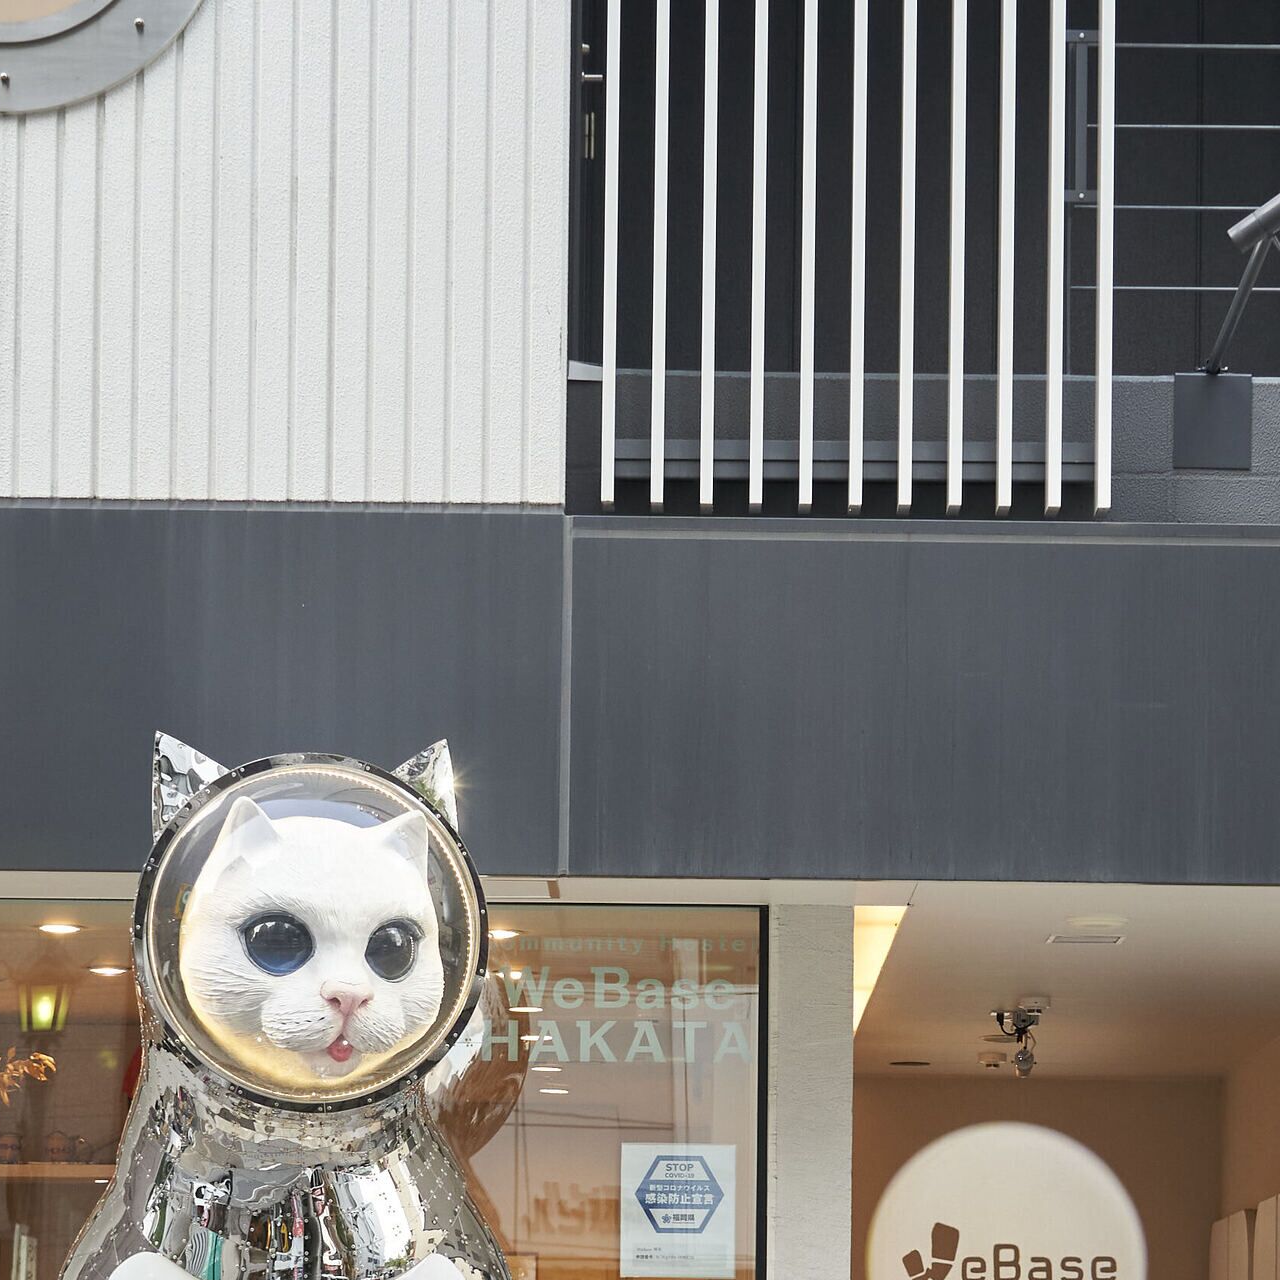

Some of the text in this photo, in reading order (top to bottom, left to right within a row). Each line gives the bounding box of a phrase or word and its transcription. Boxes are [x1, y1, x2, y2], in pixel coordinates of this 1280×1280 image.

[497, 965, 737, 1010] WeBase
[482, 1019, 753, 1063] HAKATA
[665, 1163, 694, 1172] STOP
[645, 1193, 715, 1205] 感染防止宣言
